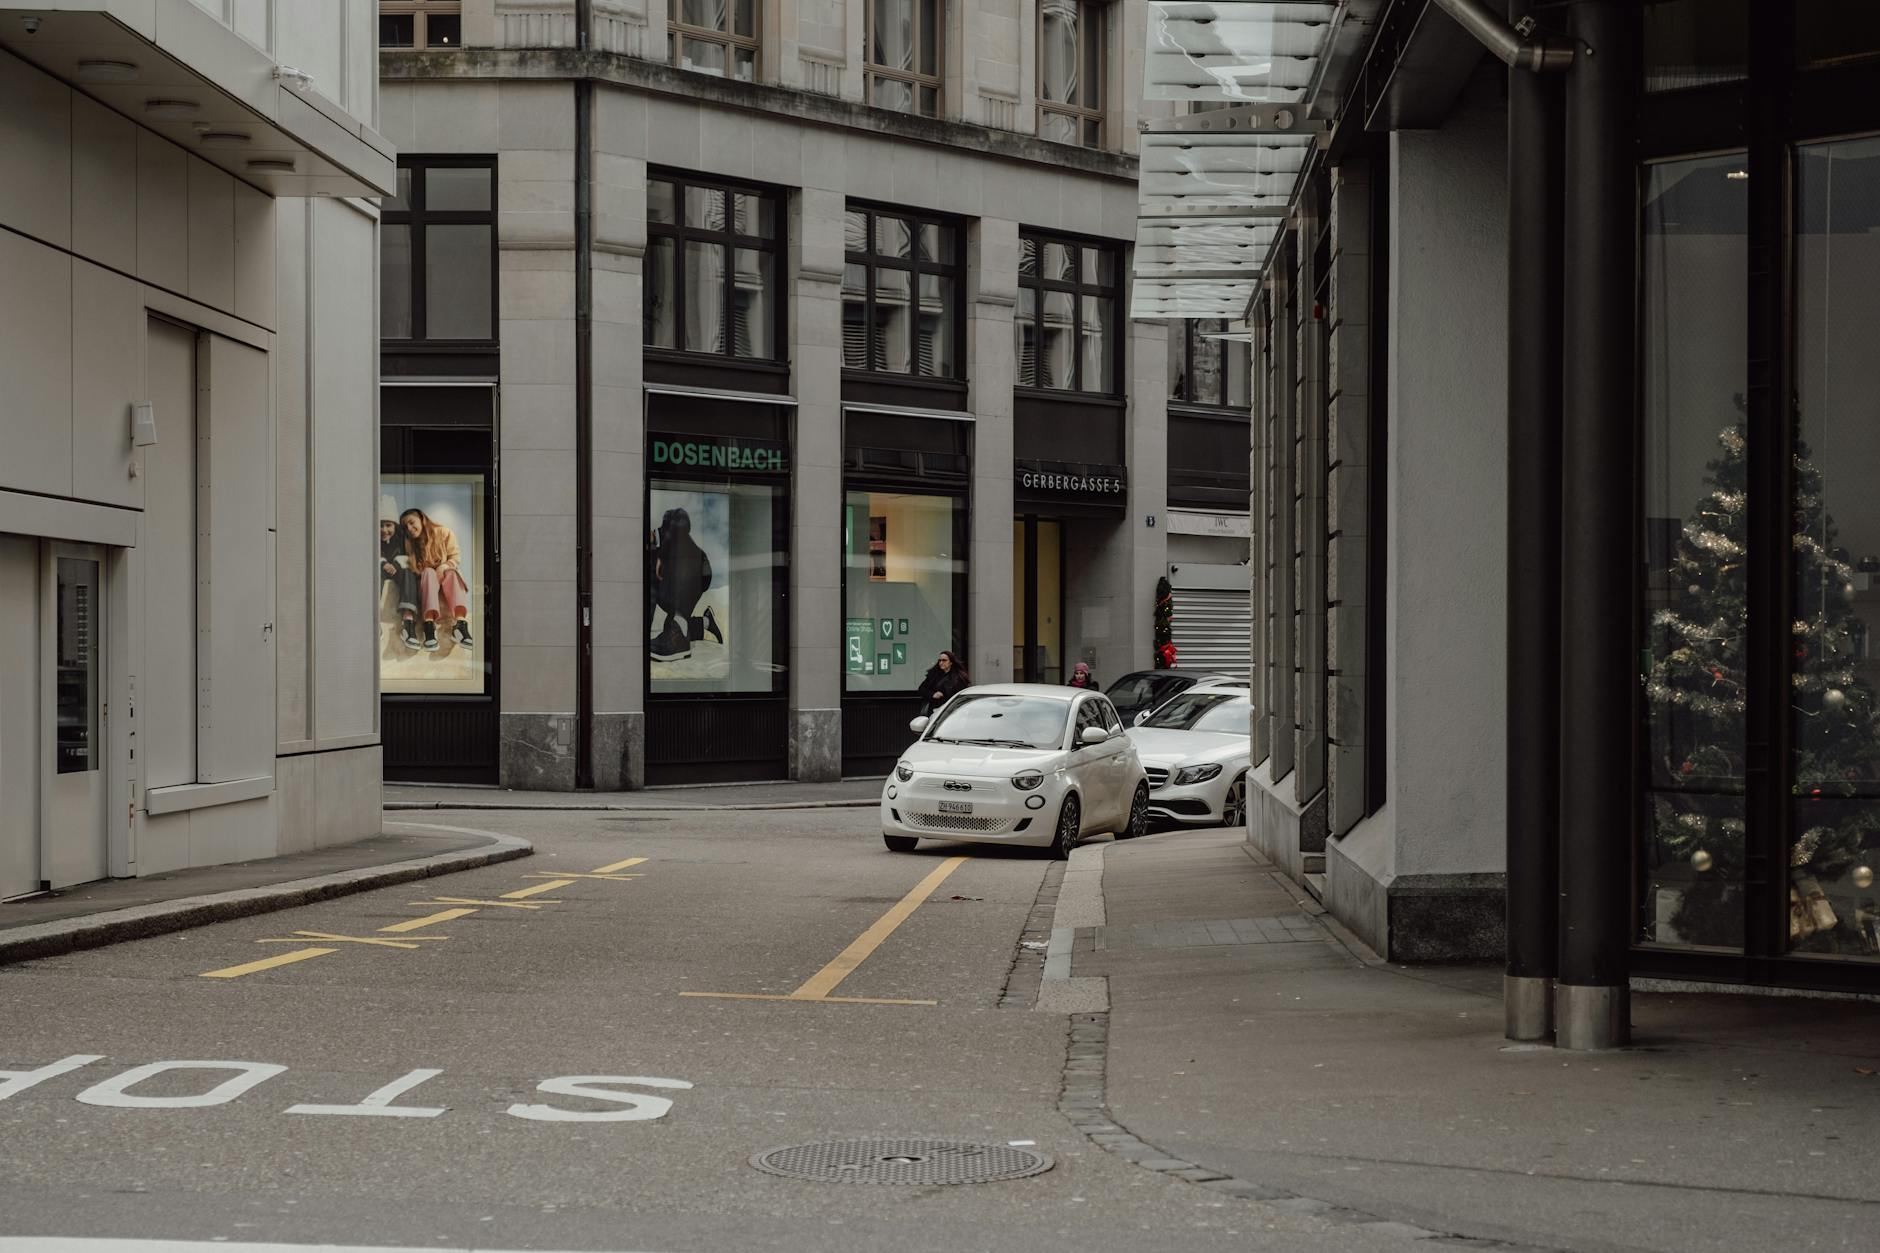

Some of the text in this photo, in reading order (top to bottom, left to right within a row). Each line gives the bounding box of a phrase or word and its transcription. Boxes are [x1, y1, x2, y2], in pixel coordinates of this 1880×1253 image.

[653, 441, 781, 471] DOSENBACH
[1023, 473, 1120, 493] GERBERGASSE 5
